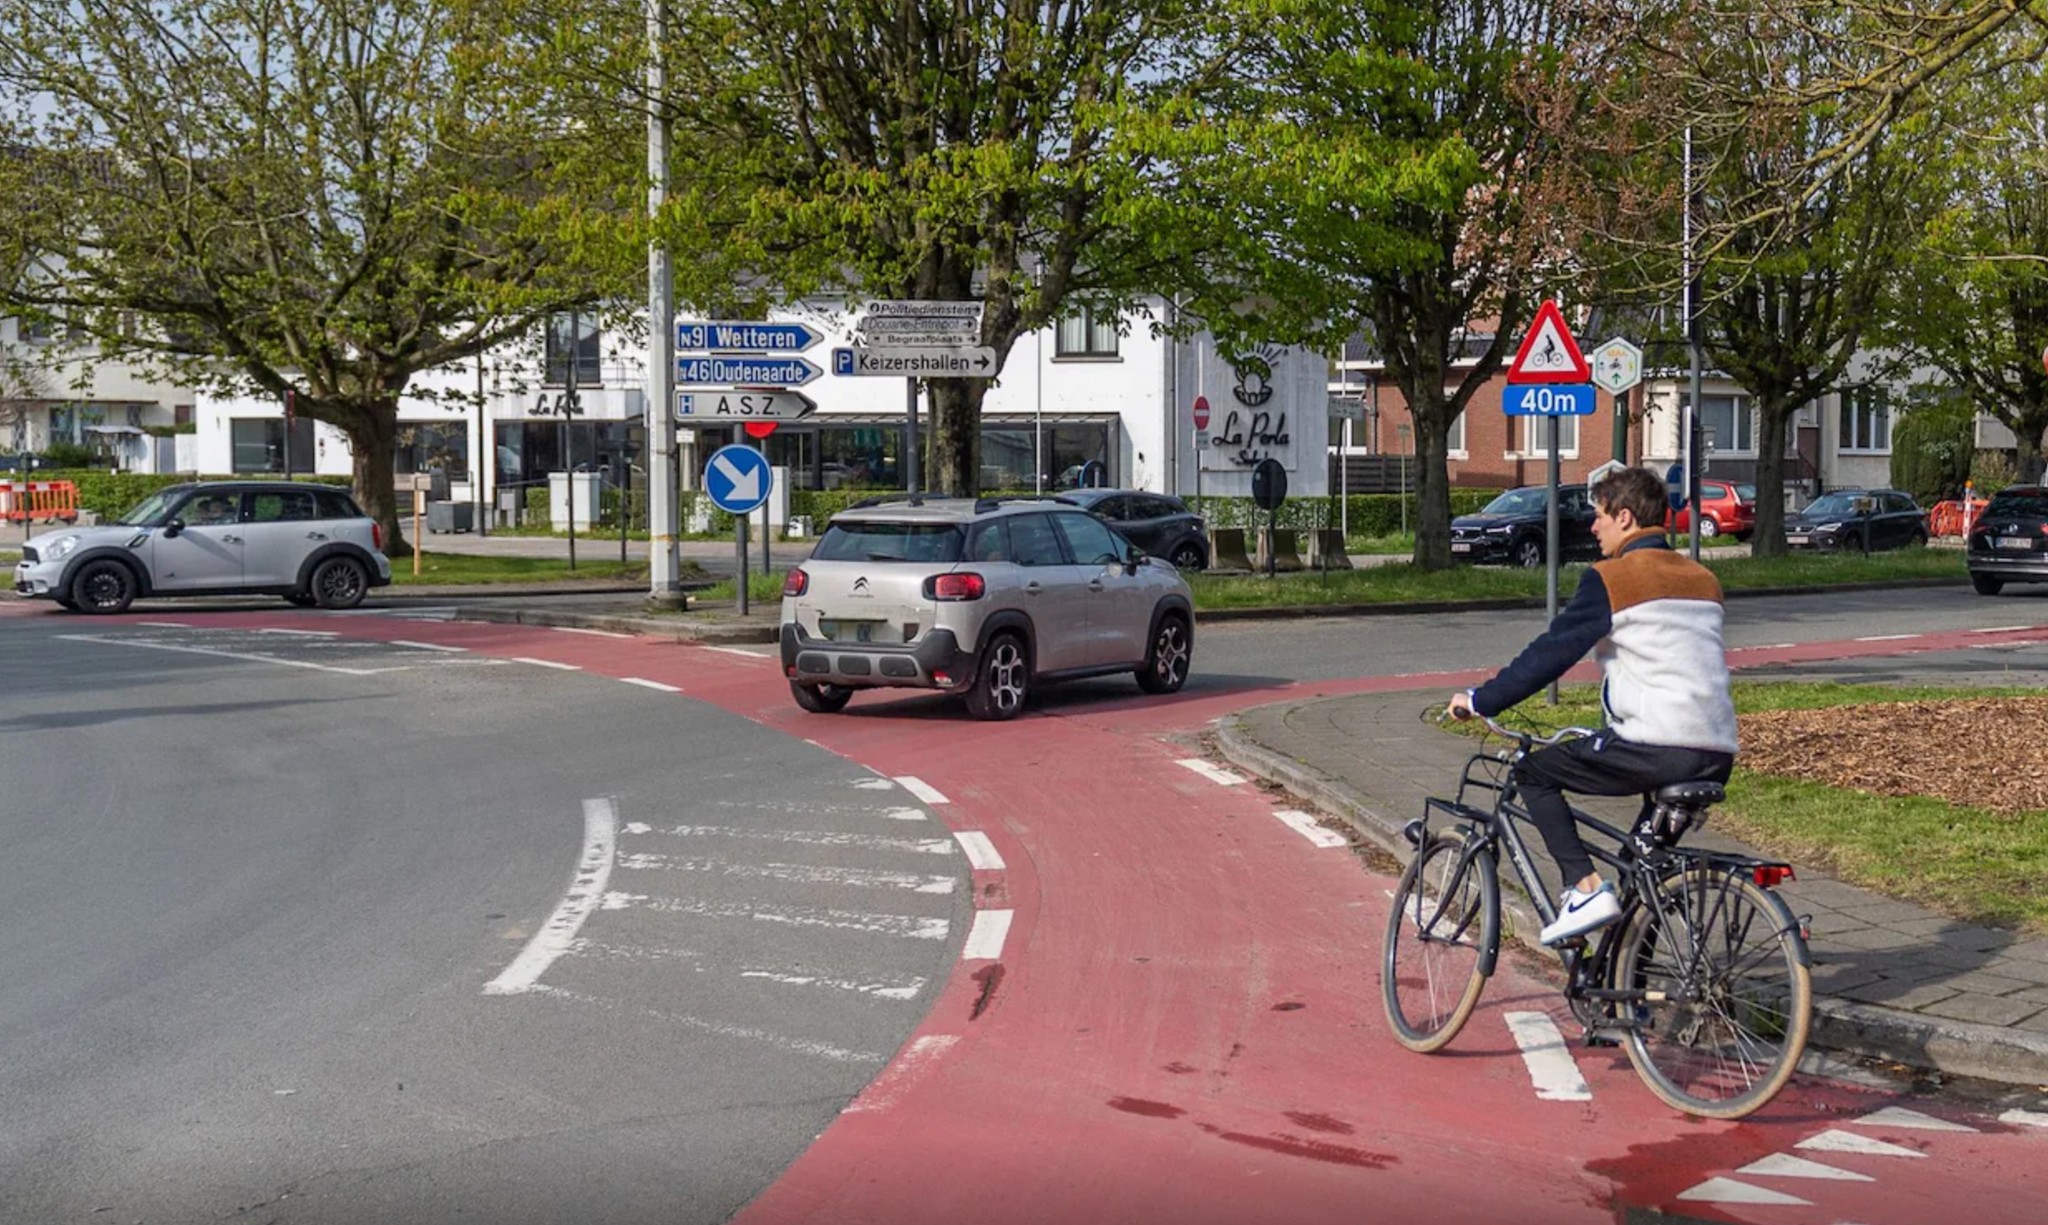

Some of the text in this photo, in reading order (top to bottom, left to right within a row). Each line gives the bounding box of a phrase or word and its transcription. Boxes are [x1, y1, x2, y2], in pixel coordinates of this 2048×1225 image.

[681, 326, 796, 348] N9 Wetteren
[888, 335, 963, 345] Begraafplaats
[714, 361, 803, 381] Oudenaarde
[838, 354, 970, 371] P Keizershallen
[680, 395, 781, 415] H A.S.Z.
[1520, 388, 1577, 413] 40m
[1211, 410, 1242, 447] La
[1247, 411, 1290, 449] Perla
